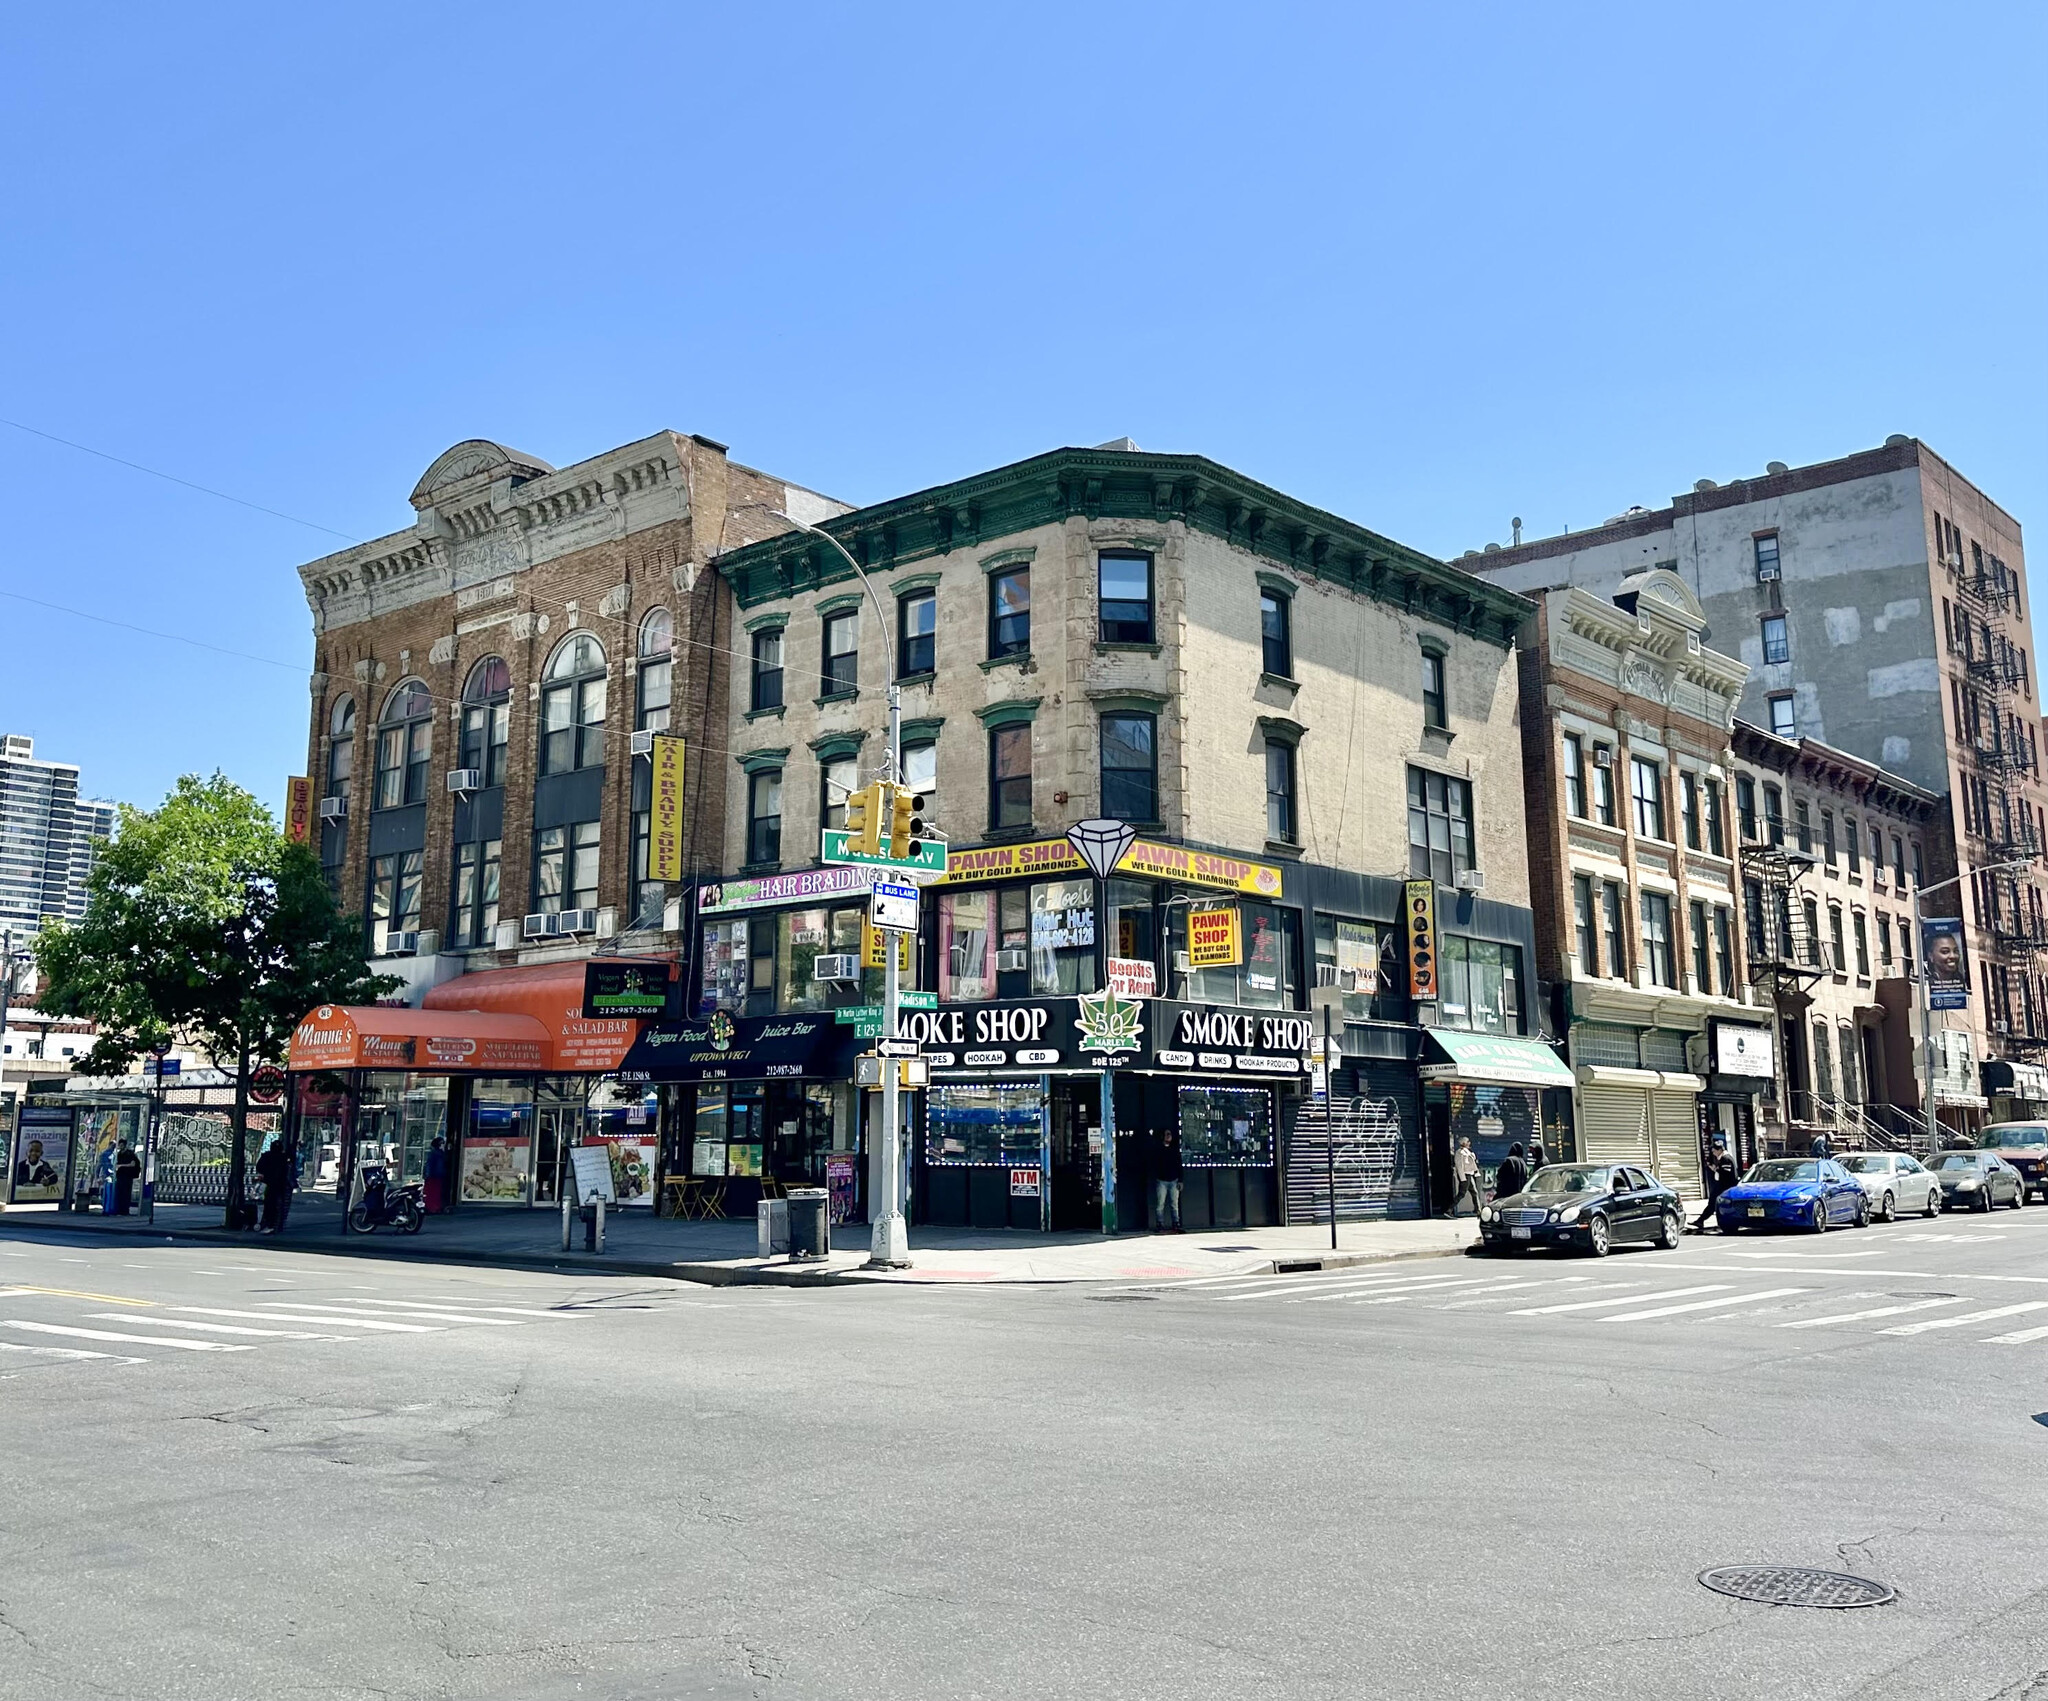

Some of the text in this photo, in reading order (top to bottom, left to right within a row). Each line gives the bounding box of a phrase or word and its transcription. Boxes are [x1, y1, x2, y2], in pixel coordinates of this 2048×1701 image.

[660, 737, 678, 770] HAIR
[291, 780, 310, 843] BEAUTY
[658, 780, 676, 829] BEAUTY
[657, 830, 675, 879] SUPPLY
[950, 849, 1013, 872] PAWN
[1123, 843, 1251, 881] PAWN SHOP
[949, 859, 1079, 881] WE BUY GOLD & DIAMONDS
[1131, 860, 1240, 888] WE BUY GOLD & DIAMONDS
[759, 877, 798, 899] HAIR
[800, 866, 877, 894] BRAIDING
[884, 886, 916, 898] BUS LANE
[1067, 907, 1094, 928] Hut
[1192, 913, 1230, 930] PAWN
[874, 934, 904, 950] SHP
[1194, 930, 1229, 945] SHOP
[1193, 944, 1231, 954] WE BUY GOLD
[1200, 951, 1231, 961] DIAMONDS
[1109, 960, 1153, 979] Booths
[1110, 978, 1156, 997] or Rent
[899, 992, 928, 1006] Madison
[566, 1007, 582, 1019] SO
[599, 1006, 658, 1015] 212-987-2660
[837, 1009, 842, 1018] Dr
[843, 1008, 855, 1018] Martin
[855, 1008, 868, 1017] Luther
[868, 1007, 877, 1017] King
[562, 1020, 628, 1035] & SALAD BAR
[856, 1024, 862, 1037] E
[863, 1024, 875, 1037] 125
[898, 1007, 1048, 1046] MOKE SHOP
[1094, 1012, 1124, 1037] 50
[1181, 1009, 1313, 1051] SMOKE SHOP
[297, 1020, 353, 1047] Manna's
[645, 1029, 709, 1047] Vegan Food
[755, 1022, 817, 1042] Juice Bar
[363, 1036, 400, 1050] Mann
[883, 1044, 914, 1053] ONE WAY
[1094, 1038, 1126, 1047] MARLEY
[689, 1051, 726, 1063] UPTOWN
[728, 1050, 745, 1061] VEG
[929, 1055, 948, 1064] APES
[967, 1053, 1003, 1062] HOOKAH
[1029, 1052, 1046, 1061] CBD
[1092, 1057, 1108, 1066] 50E
[1165, 1054, 1188, 1063] CANDY
[1204, 1056, 1228, 1065] DRINKS
[1239, 1057, 1265, 1067] HOOKAH
[1266, 1059, 1297, 1069] PRODUCTS
[702, 1069, 727, 1079] Est. 1994
[766, 1064, 803, 1076] 212-987-2660
[627, 1107, 645, 1119] ATM
[24, 1131, 68, 1142] amazing
[1012, 1171, 1037, 1185] ATM
